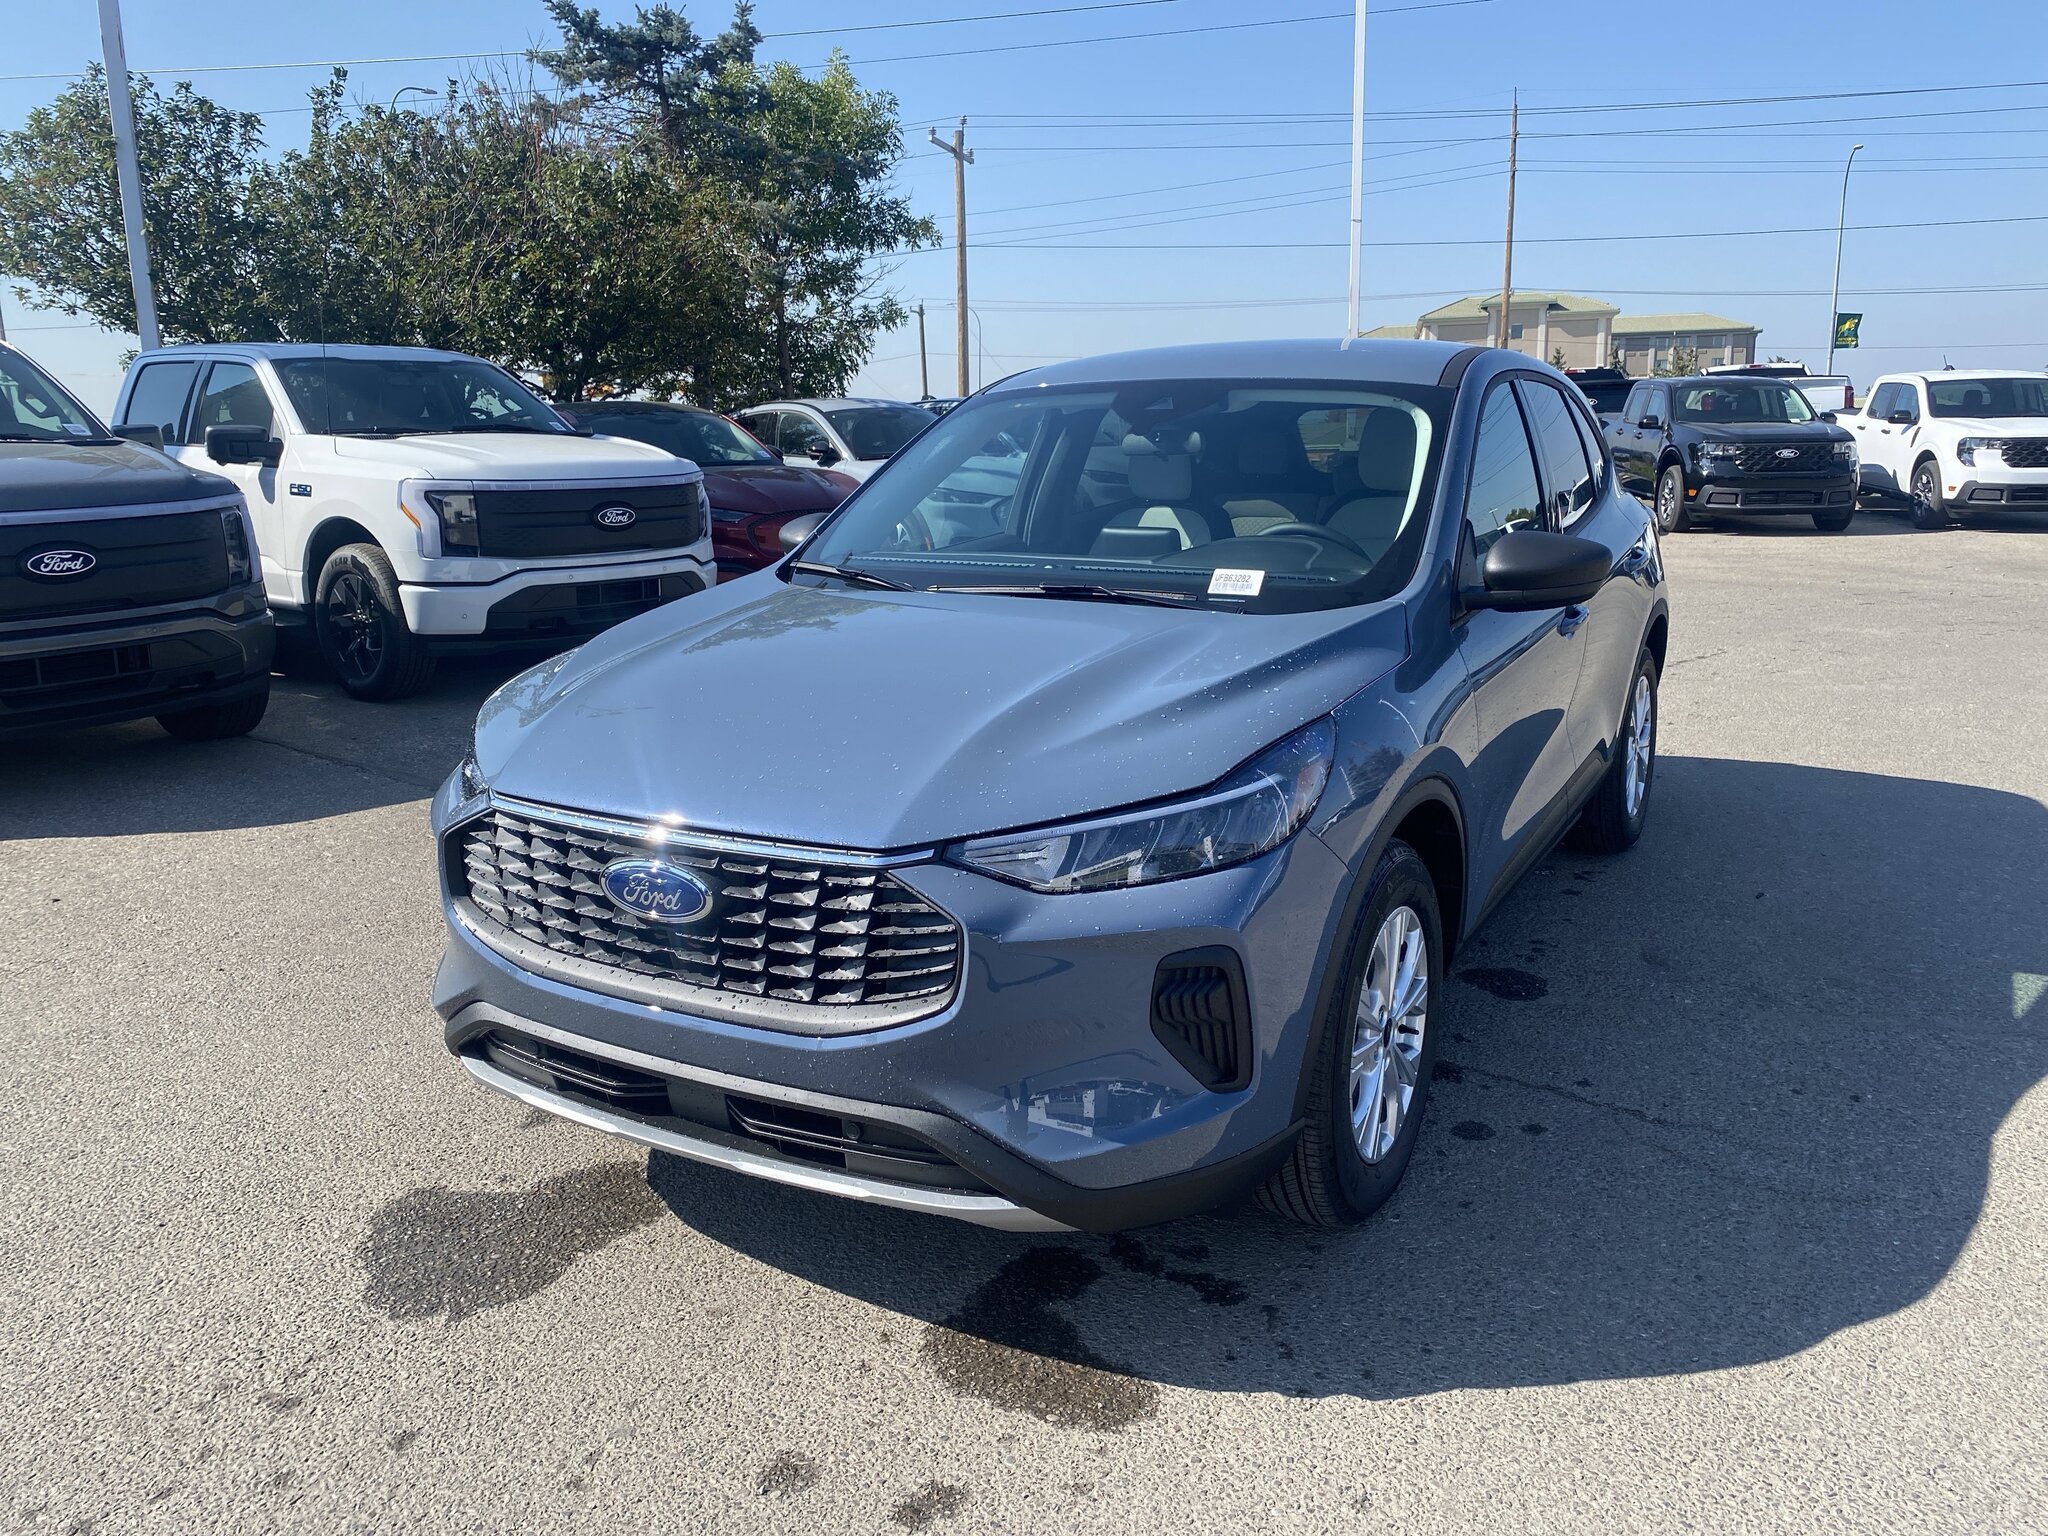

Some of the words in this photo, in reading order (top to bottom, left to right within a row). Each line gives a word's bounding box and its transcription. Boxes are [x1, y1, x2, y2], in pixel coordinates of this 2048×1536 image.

[605, 510, 629, 522] Ford
[40, 554, 84, 572] Ford
[623, 873, 682, 911] Ford
